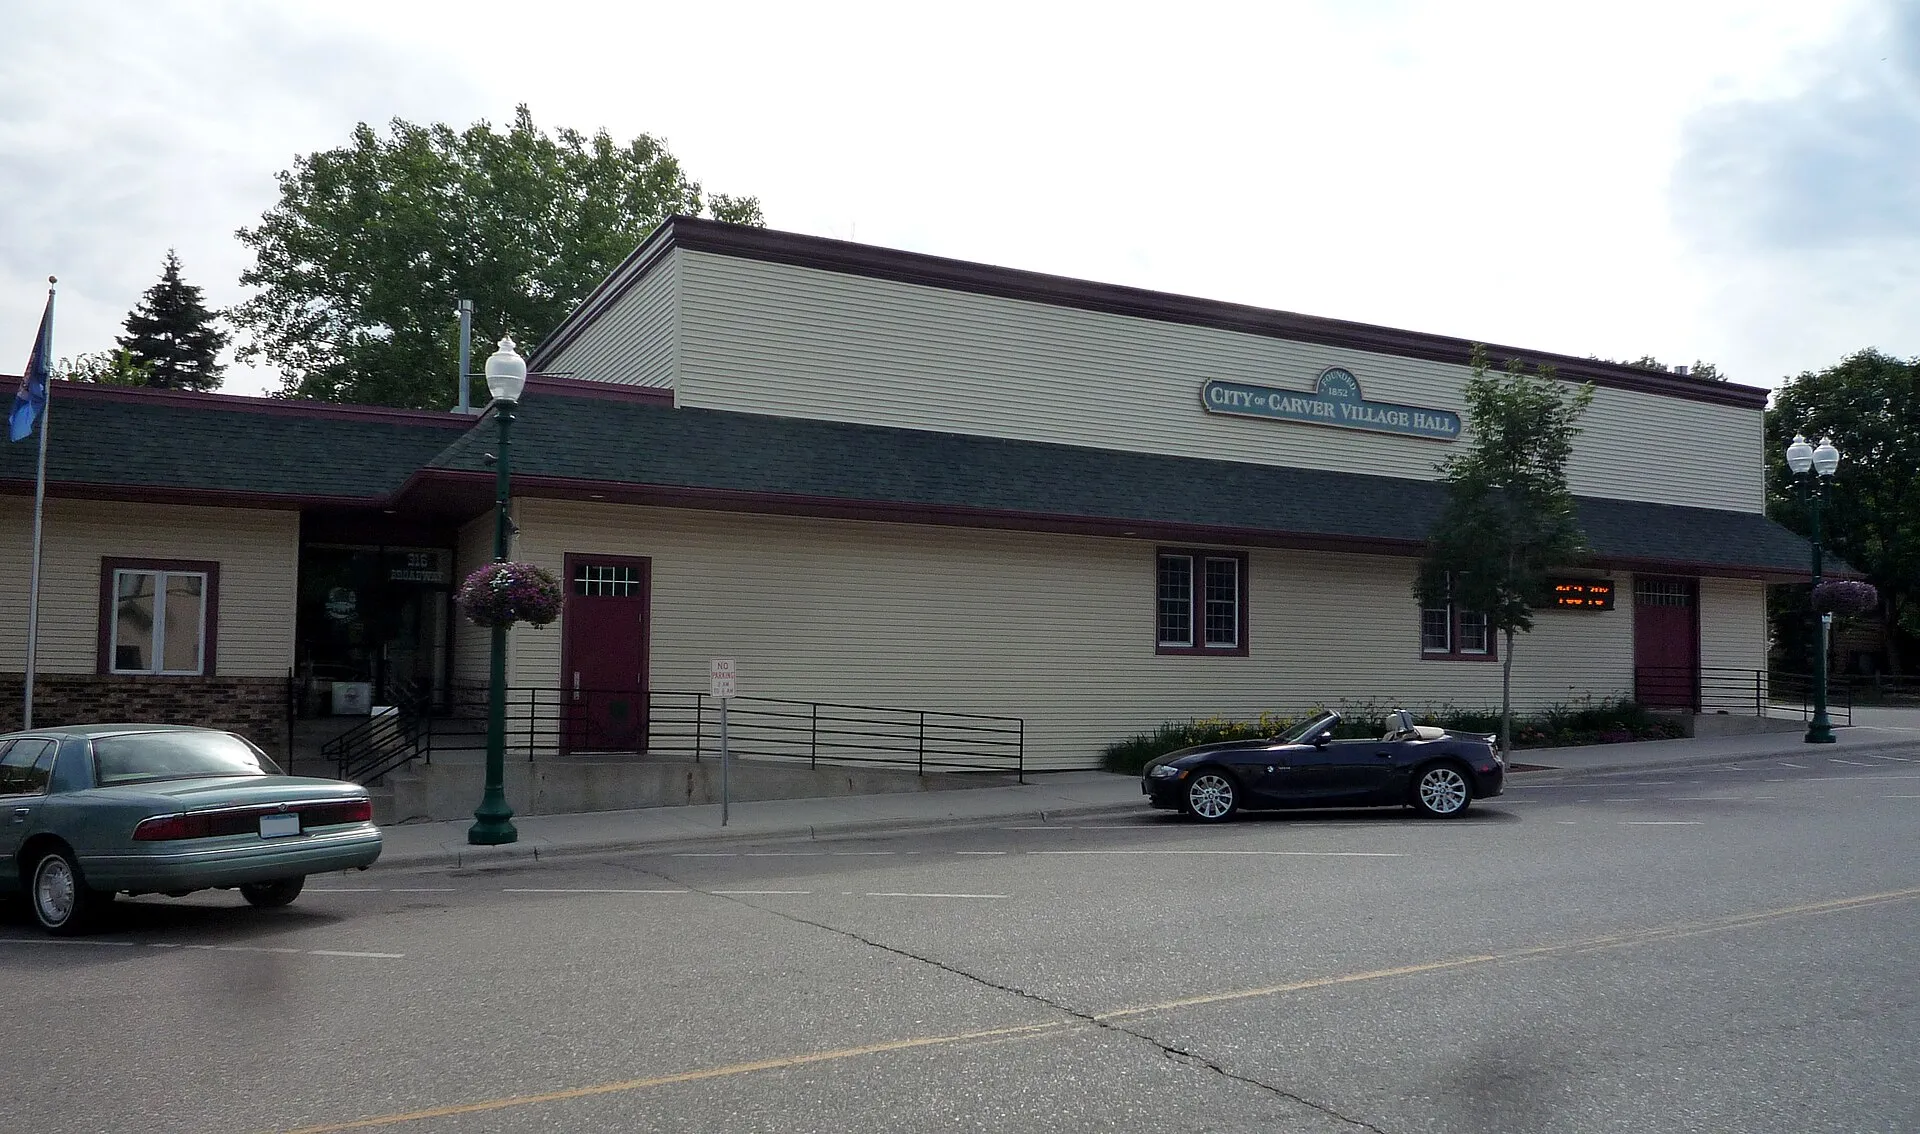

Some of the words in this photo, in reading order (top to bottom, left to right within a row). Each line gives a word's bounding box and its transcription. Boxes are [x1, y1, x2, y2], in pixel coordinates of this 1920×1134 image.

[1320, 369, 1357, 391] FOUNDED
[1328, 387, 1349, 397] 1852
[1210, 386, 1254, 408] CITY
[1268, 394, 1336, 418] CARVER
[1340, 403, 1409, 426] VILLAGE
[1414, 412, 1455, 432] HALL
[407, 553, 428, 567] 316
[717, 662, 729, 670] NO
[711, 671, 736, 679] PARKING
